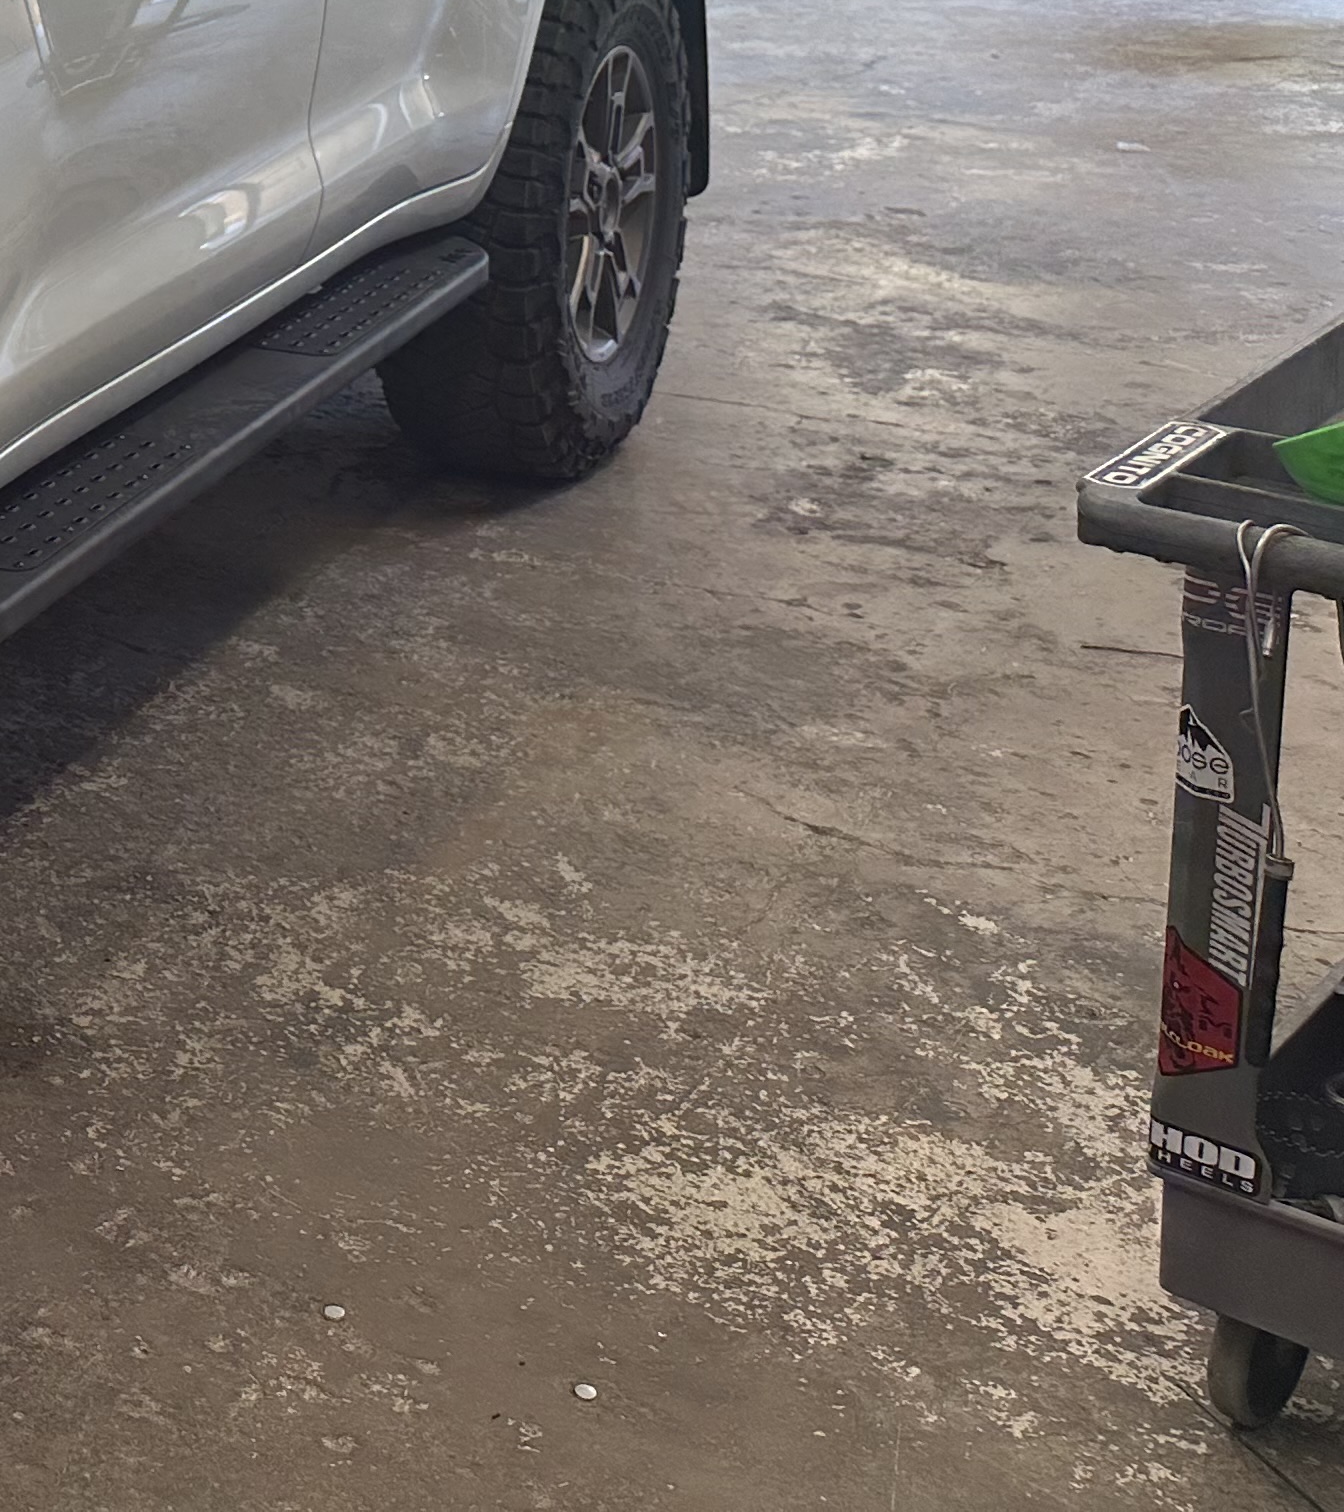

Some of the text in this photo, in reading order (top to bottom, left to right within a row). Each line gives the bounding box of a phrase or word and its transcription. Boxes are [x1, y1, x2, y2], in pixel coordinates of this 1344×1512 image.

[1102, 426, 1208, 485] COGNITO
[1177, 743, 1230, 776] ose
[1208, 803, 1273, 991] TURBOSMART
[1150, 1118, 1256, 1181] HOD
[1157, 1148, 1255, 1194] HEELS
